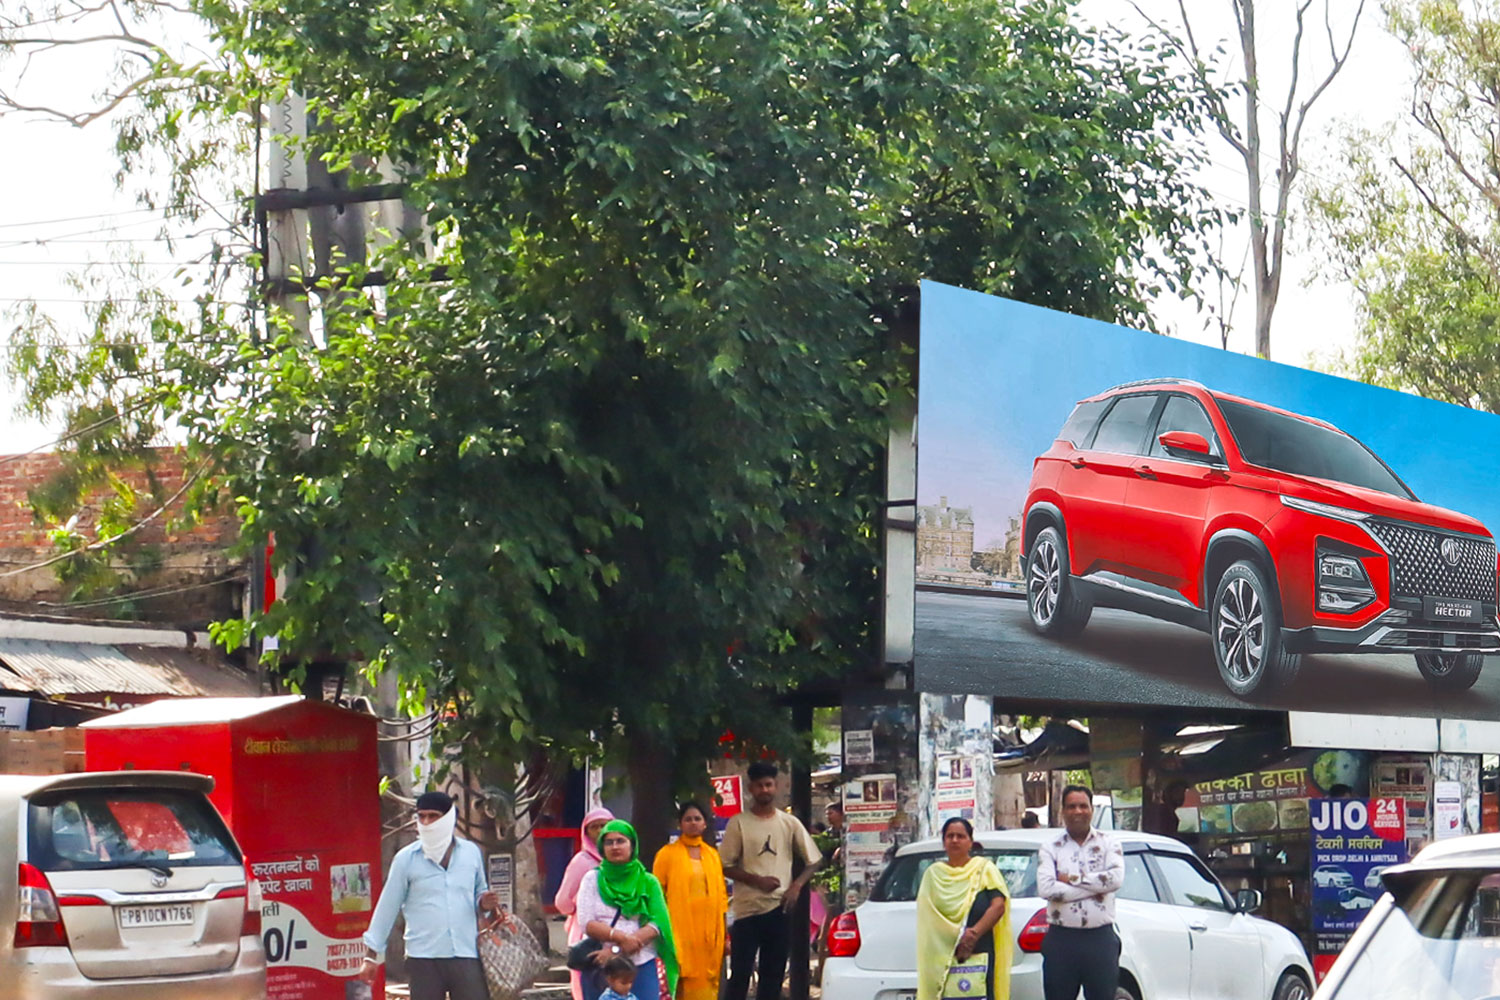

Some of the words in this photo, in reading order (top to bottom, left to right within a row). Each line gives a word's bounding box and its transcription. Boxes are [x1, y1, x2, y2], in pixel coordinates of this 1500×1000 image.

[1435, 607, 1472, 617] HECTOR
[1259, 768, 1307, 788] ढाबा
[714, 780, 733, 793] 24
[1376, 799, 1397, 813] 24
[1312, 801, 1368, 831] JIO
[252, 856, 302, 877] रूरतमन्दों
[304, 855, 320, 873] को
[261, 878, 281, 894] रपेट
[284, 878, 313, 893] खाना
[128, 907, 192, 924] PB10CN1766
[262, 902, 280, 917] ाली
[263, 919, 307, 963] 0/-
